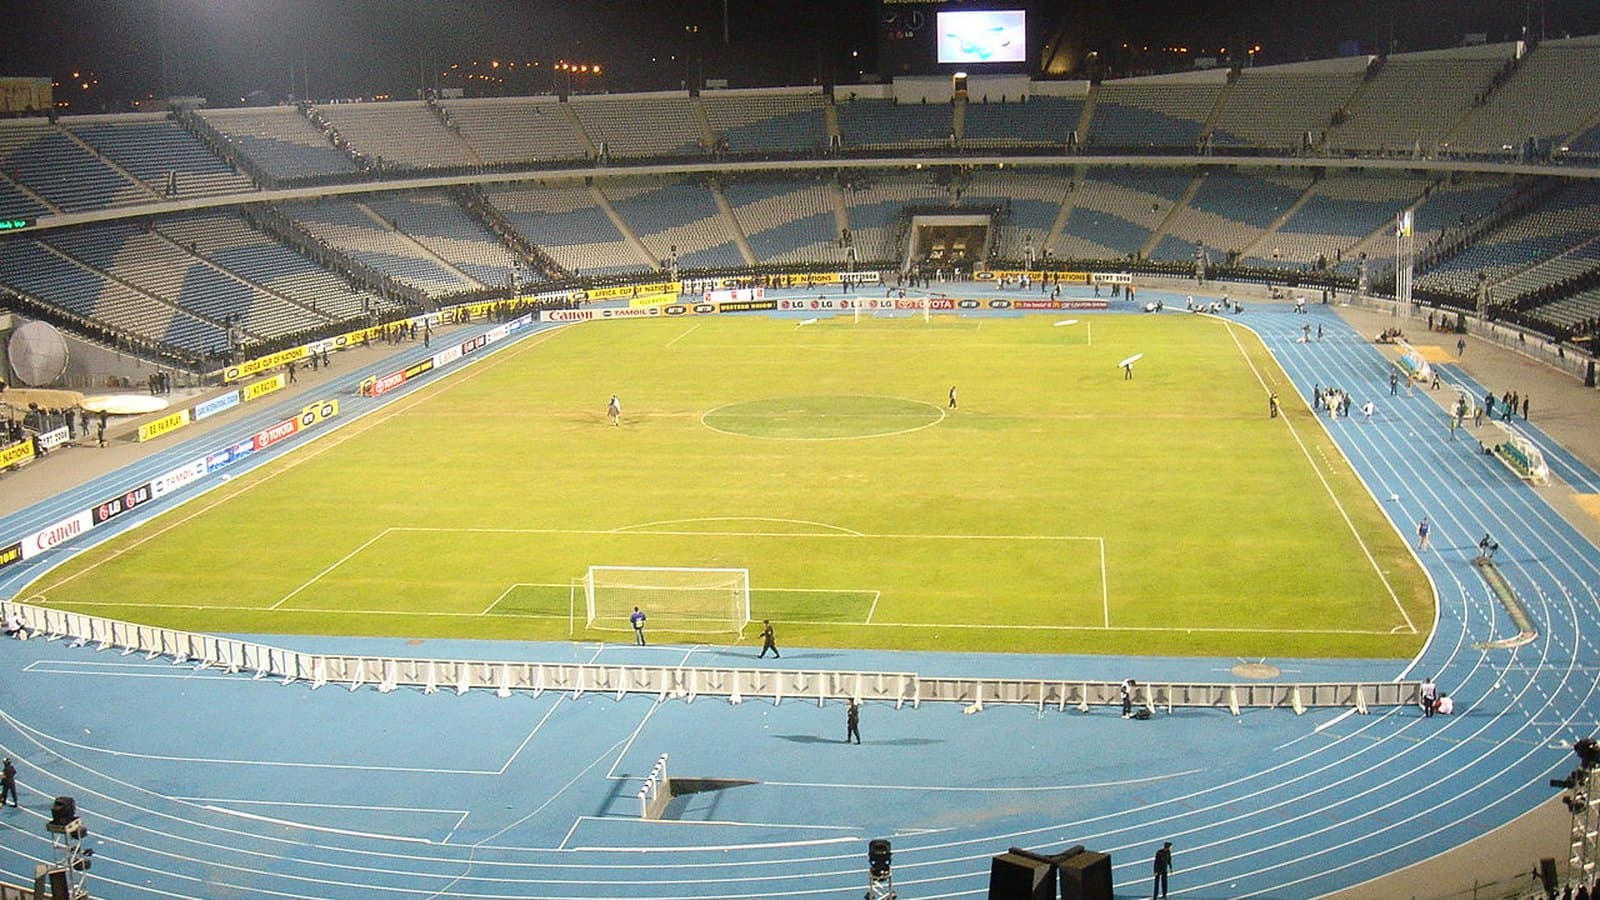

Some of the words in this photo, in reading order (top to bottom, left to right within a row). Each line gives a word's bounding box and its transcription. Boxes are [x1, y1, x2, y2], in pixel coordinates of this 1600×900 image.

[549, 310, 593, 320] Canon
[269, 422, 294, 440] TOYOTA
[3, 444, 29, 463] NATIONS
[37, 519, 80, 549] Canon
